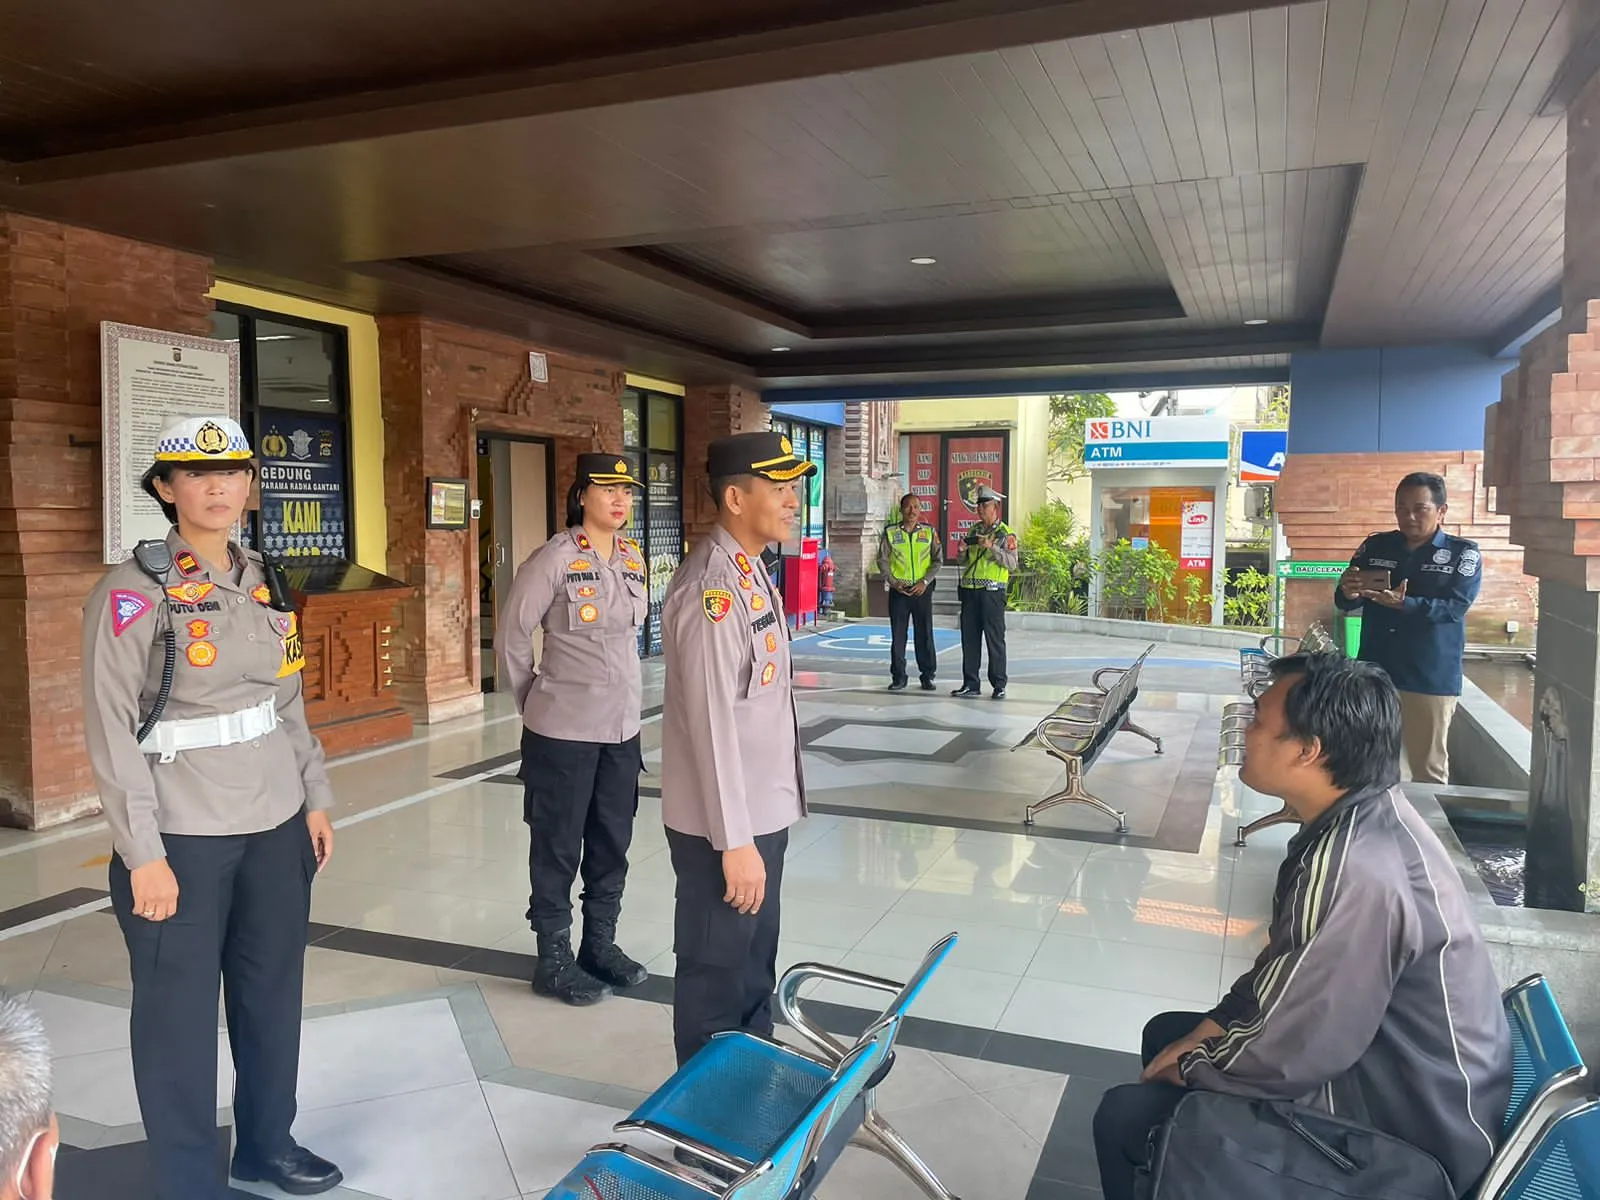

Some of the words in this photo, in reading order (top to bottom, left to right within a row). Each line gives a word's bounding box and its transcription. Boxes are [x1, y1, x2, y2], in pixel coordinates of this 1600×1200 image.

[1111, 421, 1151, 438] BNI
[1090, 446, 1122, 458] ATM
[260, 466, 312, 481] GEDUNG
[282, 500, 321, 534] KAMI
[1187, 559, 1206, 568] ATM
